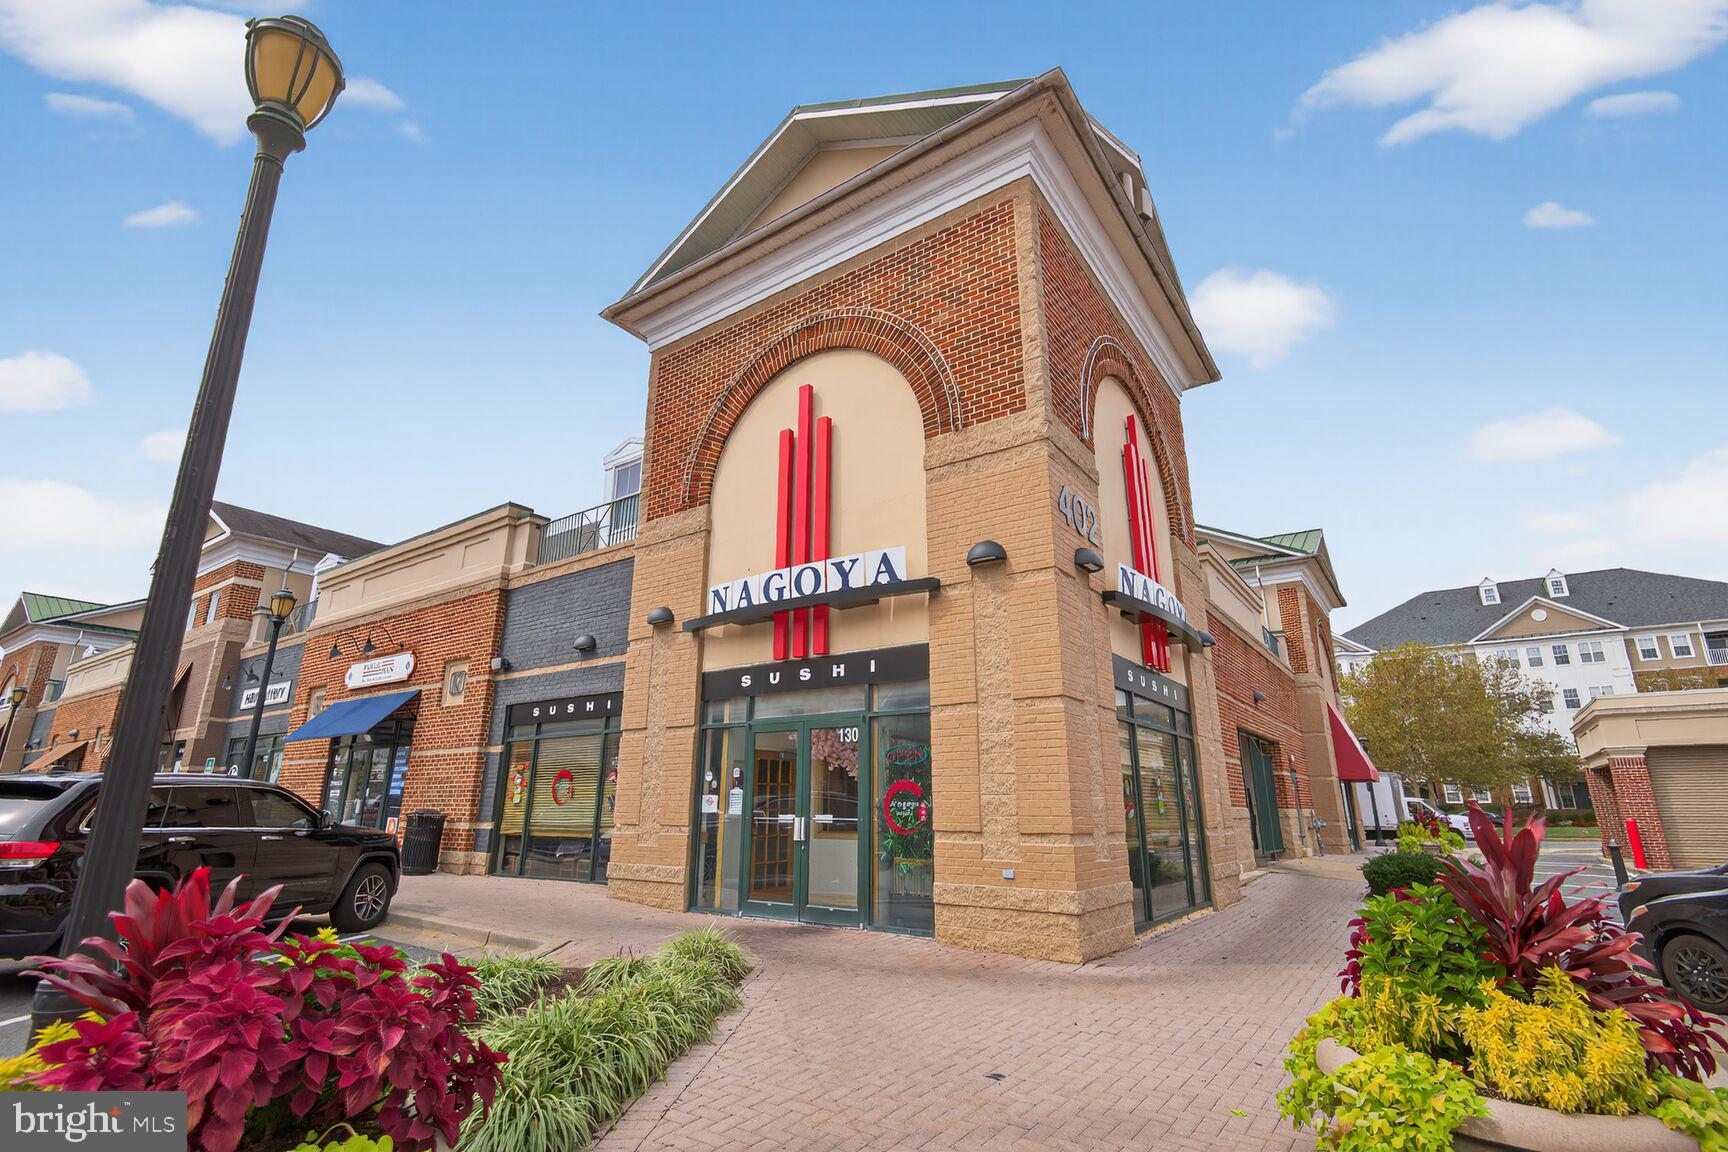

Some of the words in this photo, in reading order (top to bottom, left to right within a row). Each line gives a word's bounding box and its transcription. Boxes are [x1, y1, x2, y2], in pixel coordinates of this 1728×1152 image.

[1058, 484, 1102, 548] 402
[711, 552, 904, 614] NAGOYA
[1120, 566, 1187, 623] NAGOY
[741, 660, 876, 687] SUSHI
[1127, 669, 1178, 700] SUSHI
[533, 700, 611, 716] SUSHI
[838, 728, 859, 742] 130
